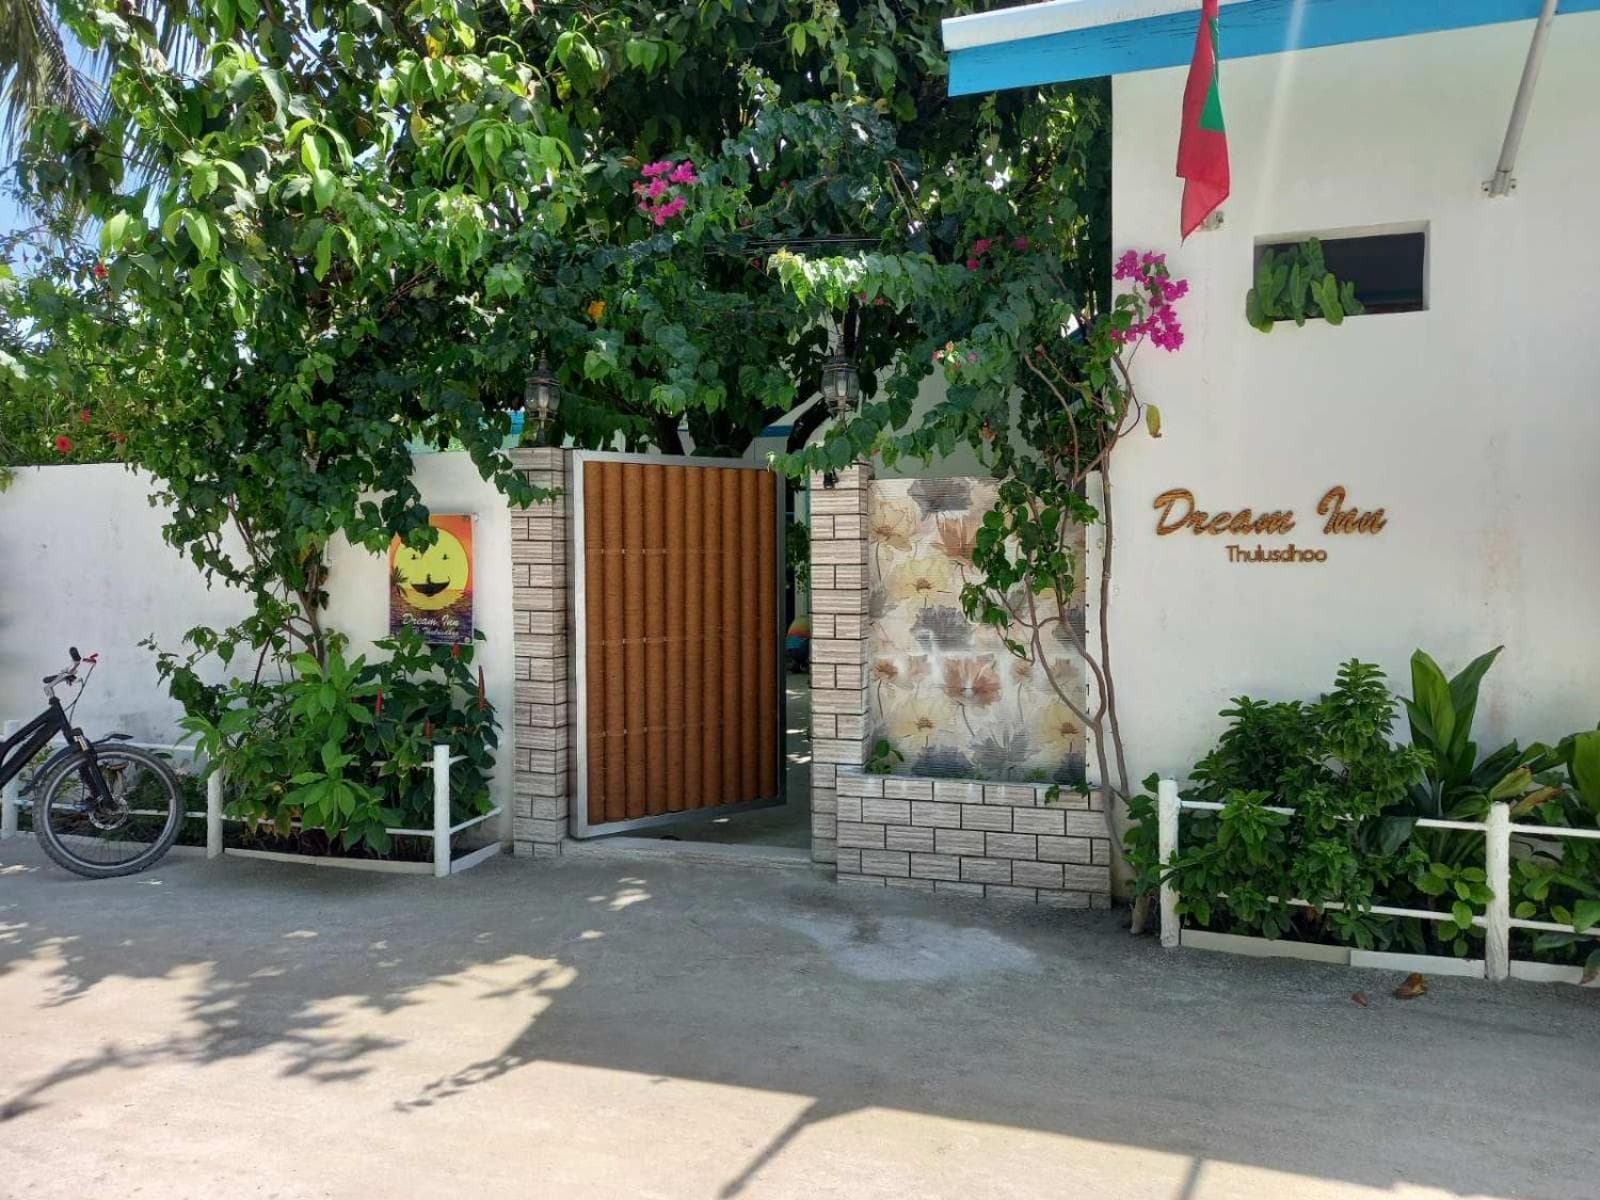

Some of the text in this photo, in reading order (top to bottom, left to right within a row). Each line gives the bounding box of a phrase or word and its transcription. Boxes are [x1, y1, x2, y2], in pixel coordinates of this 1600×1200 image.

[1153, 485, 1388, 536] Dream Inn
[1225, 544, 1328, 563] Thulusdhoo
[402, 612, 460, 627] Dream Inn
